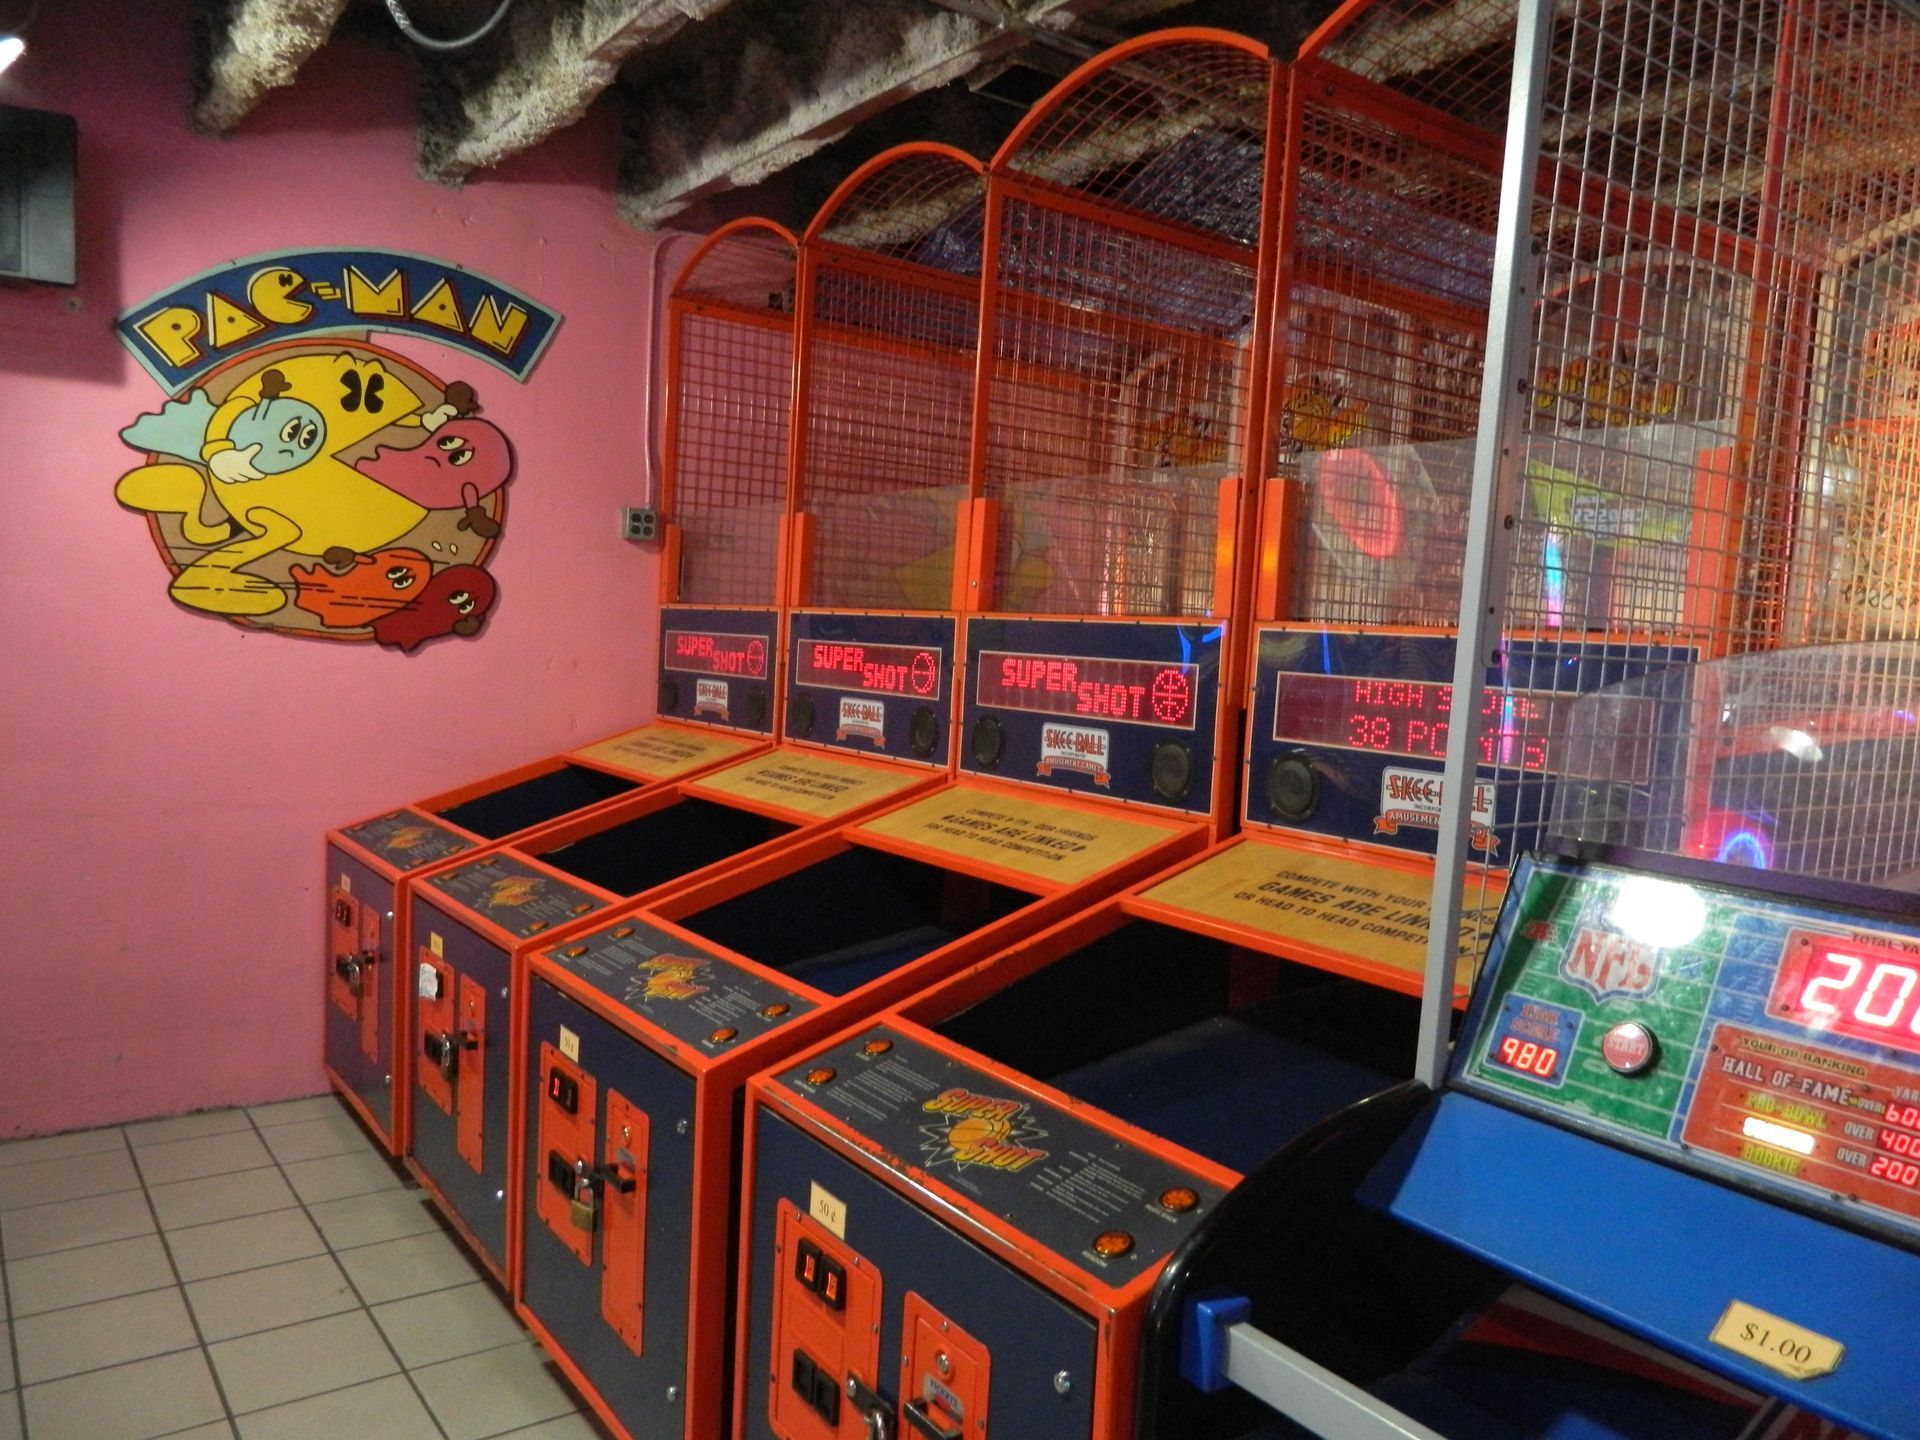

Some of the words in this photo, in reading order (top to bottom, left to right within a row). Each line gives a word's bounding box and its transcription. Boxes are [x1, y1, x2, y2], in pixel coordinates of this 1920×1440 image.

[133, 264, 530, 368] PAC-MAN
[676, 635, 714, 657] SUPER
[712, 650, 745, 673] SHOT
[813, 645, 864, 671] SUPER
[863, 663, 907, 690] SHOT
[1001, 658, 1078, 692] SUPER
[1076, 682, 1145, 717] SHOT
[1354, 680, 1424, 708] HIGH
[1436, 686, 1539, 718] SORE
[1044, 728, 1106, 756] SKEE-BALL
[1348, 714, 1391, 749] 38
[1407, 720, 1546, 767] PONTS
[1388, 812, 1440, 825] AMUSEMEN
[1258, 881, 1337, 904] GAMES
[1332, 899, 1385, 917] ARE
[1275, 870, 1341, 889] COMPETE
[1342, 884, 1382, 899] WITH
[1384, 894, 1427, 909] YOUR
[1256, 896, 1295, 910] HEAD
[1297, 905, 1318, 917] TO
[1317, 911, 1358, 928] HEAD
[1851, 933, 1895, 950] TOTAL
[1568, 927, 1653, 991] NFL
[1800, 952, 1920, 1035] 20
[1503, 1037, 1557, 1077] 980
[1742, 1035, 1778, 1051] YOUR
[1801, 1052, 1867, 1077] RANKING
[1721, 1056, 1764, 1082] HALL
[1772, 1069, 1794, 1088] OF
[1799, 1077, 1852, 1106] FAME
[922, 1087, 1022, 1122] SUPER
[1857, 1098, 1882, 1113] OVER
[1885, 1103, 1920, 1130] 60
[1843, 1121, 1875, 1141] OVER
[953, 1137, 1049, 1173] SHOT
[1836, 1148, 1868, 1168] OVER
[1870, 1156, 1919, 1186] 200
[1740, 1322, 1812, 1364] $1.00
